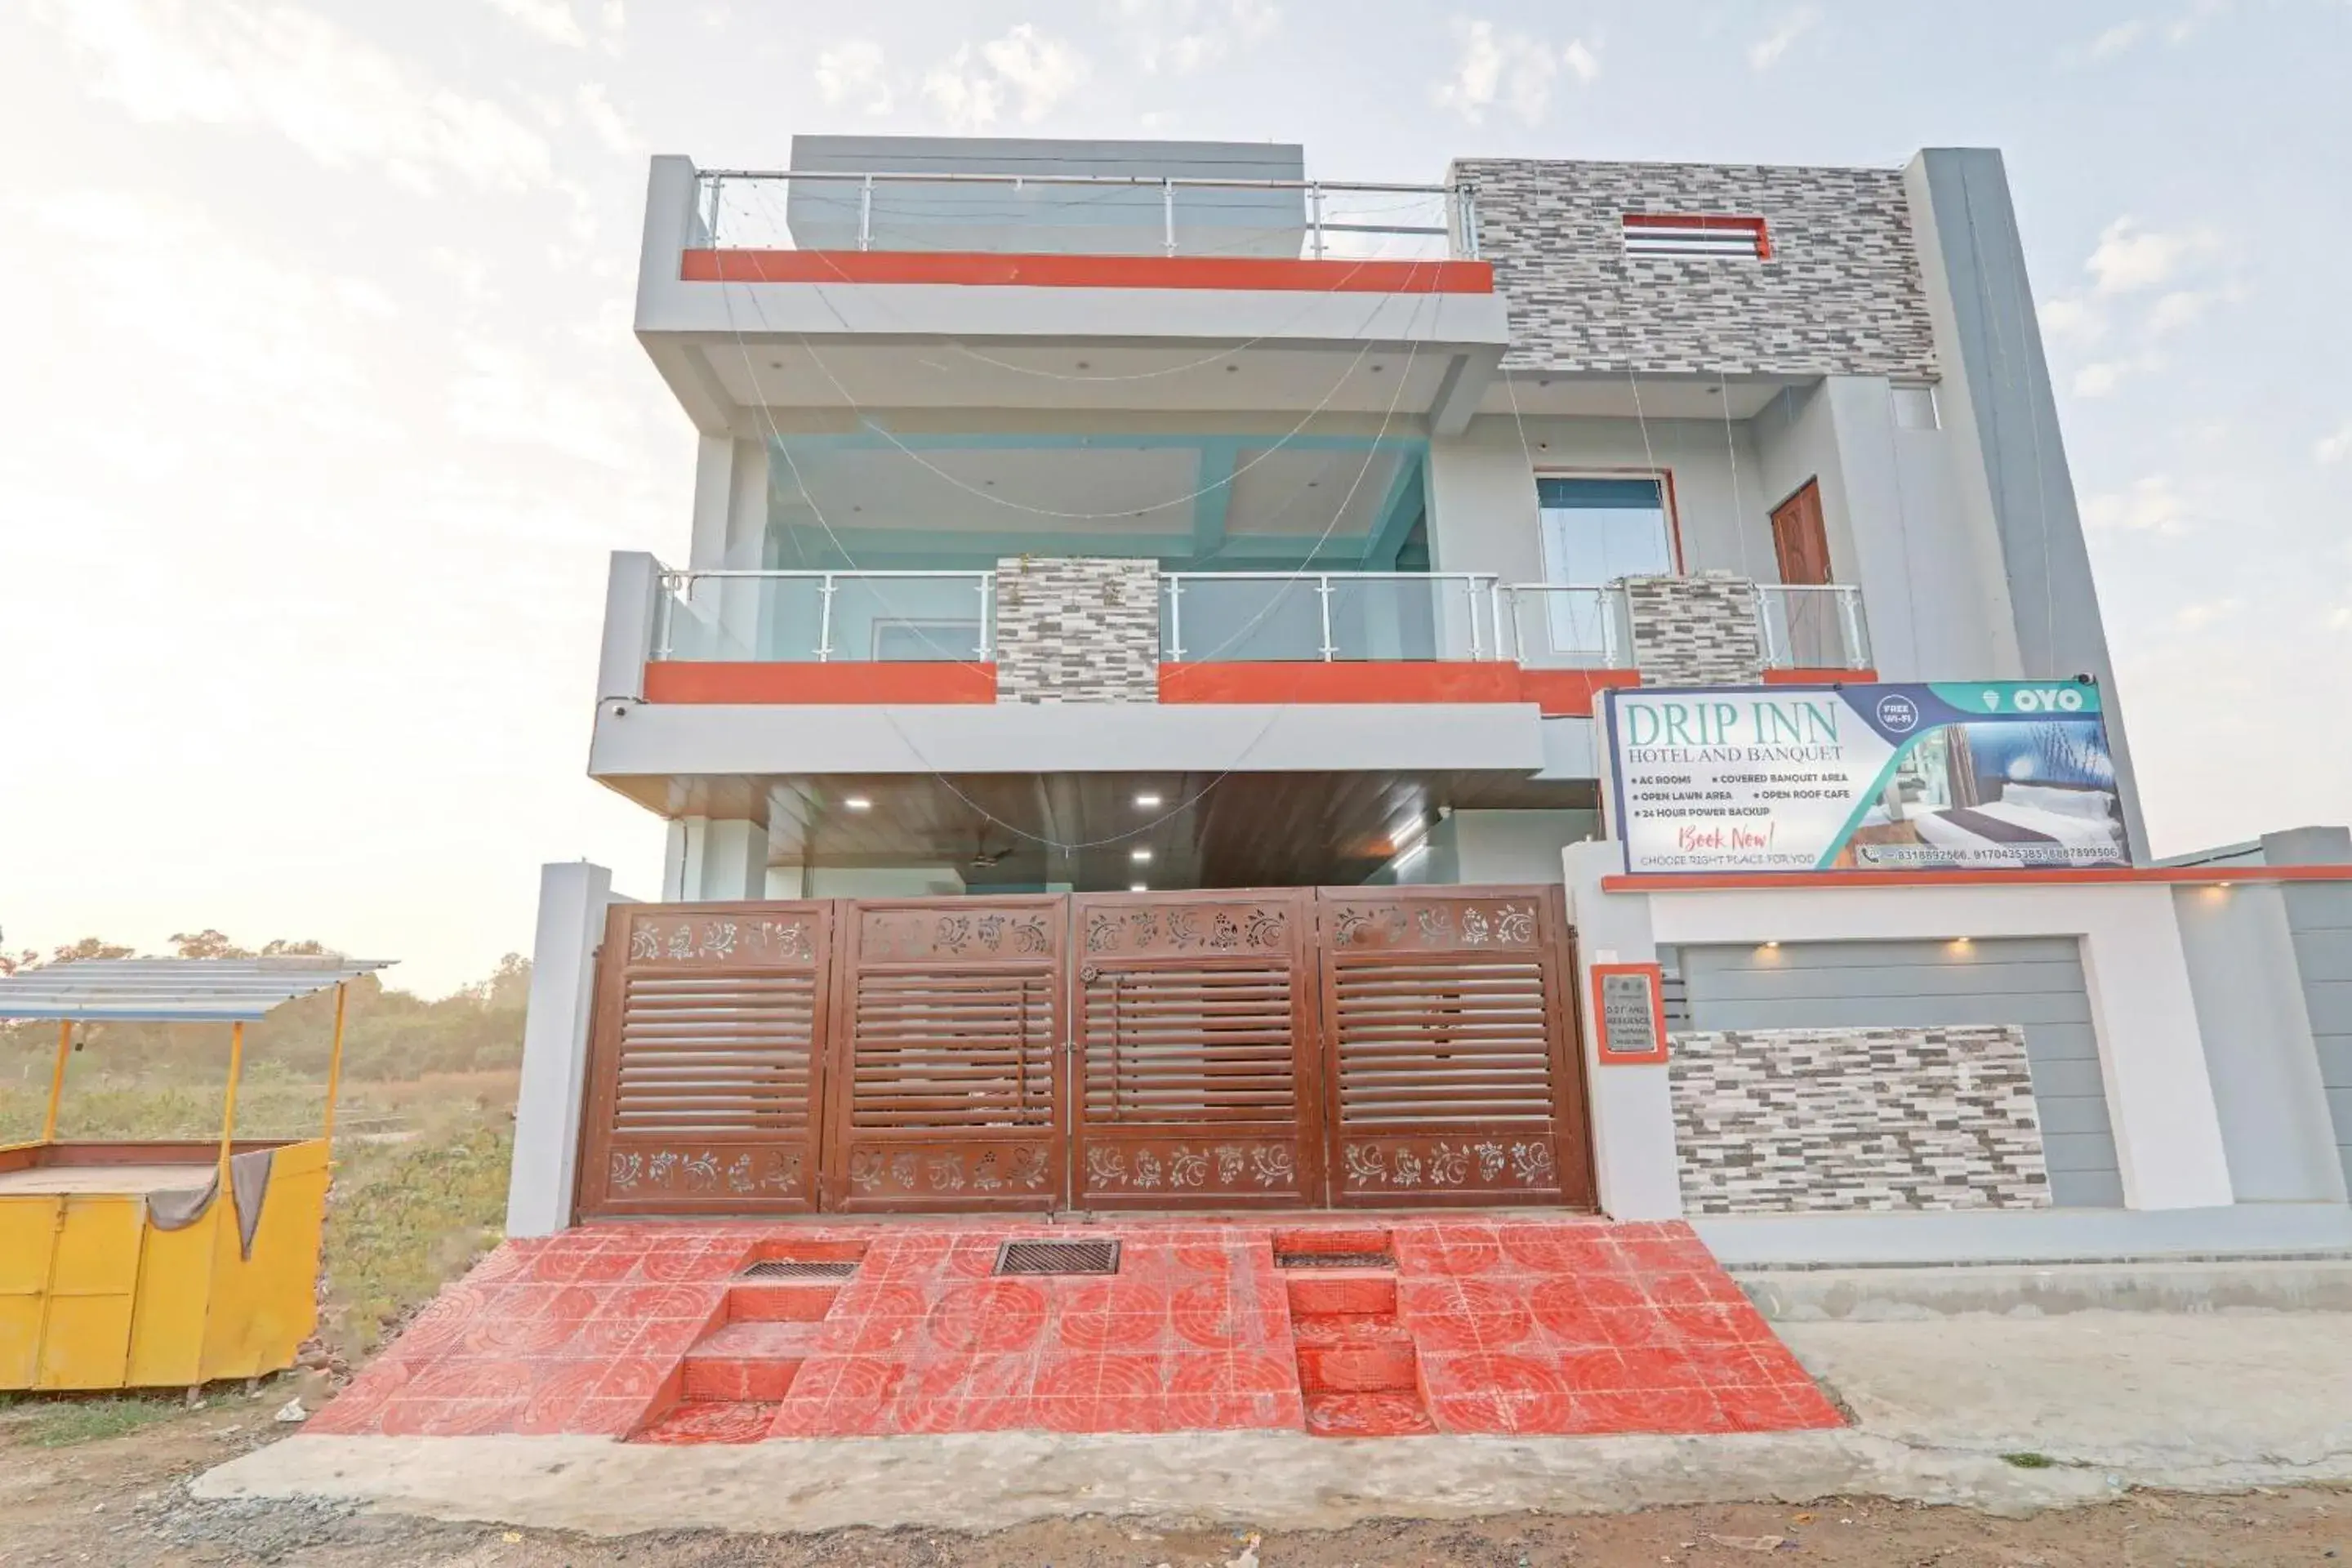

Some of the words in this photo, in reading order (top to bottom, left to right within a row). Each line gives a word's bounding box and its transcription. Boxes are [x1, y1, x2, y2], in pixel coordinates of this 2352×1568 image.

[2014, 689, 2082, 712] OYO
[1883, 705, 1909, 713] FREE
[1625, 702, 1737, 746] DRIP
[1749, 701, 1841, 744] INN
[1629, 748, 1694, 764] HOTEL
[1699, 748, 1741, 763] AND
[1748, 746, 1843, 763] BANQUET
[1639, 776, 1653, 784] AC
[1655, 776, 1691, 784] ROOMS
[1721, 773, 1767, 783] COVERED
[1770, 773, 1818, 782] BANQUET
[1821, 773, 1848, 782] AREA
[1641, 792, 1669, 800] OPEN
[1673, 791, 1703, 800] LAWN
[1705, 791, 1732, 800] AREA
[1762, 790, 1791, 799] OPEN
[1793, 790, 1821, 799] ROOF
[1824, 789, 1850, 798] CAFE
[1642, 809, 1654, 817] 24
[1656, 808, 1686, 817] HOUR
[1689, 808, 1726, 817] POWER
[1729, 807, 1770, 817] BACKUP
[1678, 824, 1726, 851] Book
[1731, 822, 1775, 850] Now!
[1641, 855, 1686, 866] CHOOSE
[1690, 855, 1723, 865] RIGHT
[1726, 854, 1763, 864] PLACE
[1766, 854, 1788, 863] FOR
[1791, 853, 1815, 864] YOU
